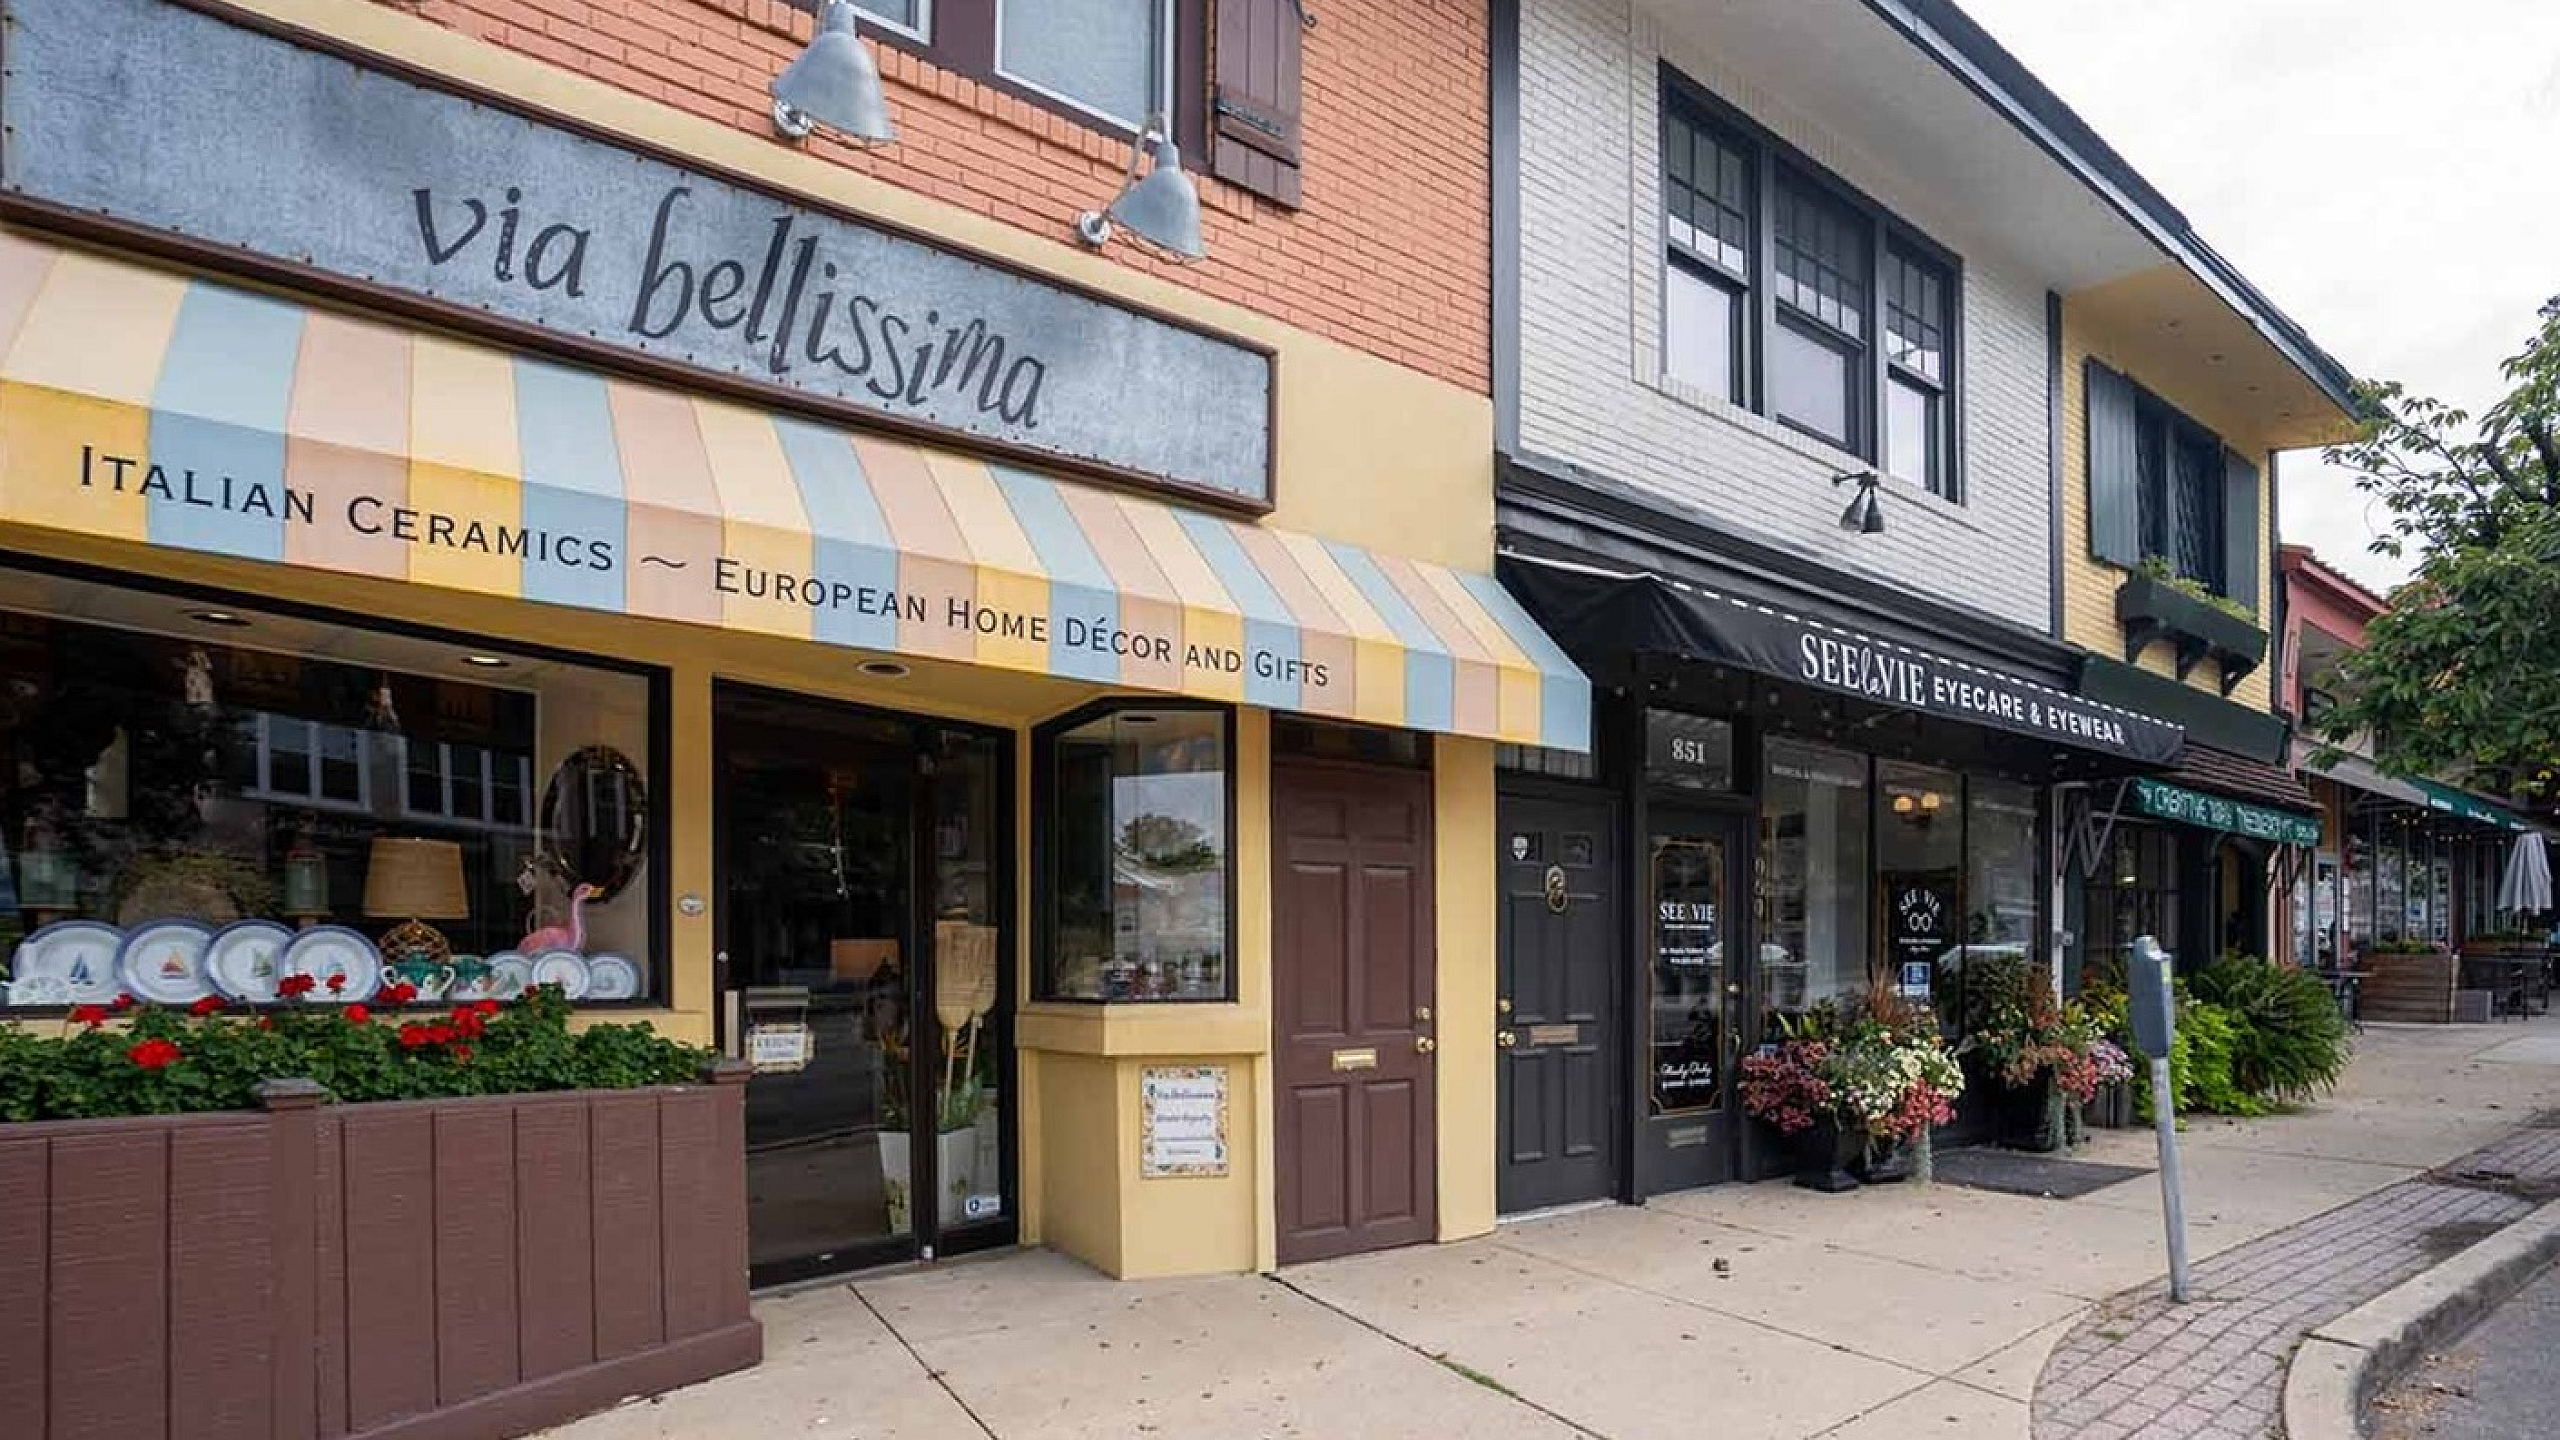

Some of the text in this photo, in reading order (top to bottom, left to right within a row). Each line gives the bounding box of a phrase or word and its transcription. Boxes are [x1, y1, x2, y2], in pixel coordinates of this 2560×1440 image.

[413, 185, 1046, 429] via bellissima
[80, 444, 314, 525] ITALIAN
[347, 495, 613, 572] CERAMICS
[715, 557, 927, 623] EUROPEAN
[947, 597, 1047, 643] HOME
[1066, 615, 1172, 663] DÉCOR
[1185, 642, 1242, 674] AND
[1254, 649, 1330, 687] GIFTS
[1671, 737, 1706, 764] 851
[1933, 675, 2024, 721] EYECARE
[2030, 702, 2043, 726] &
[2048, 706, 2125, 745] EYEWEAR
